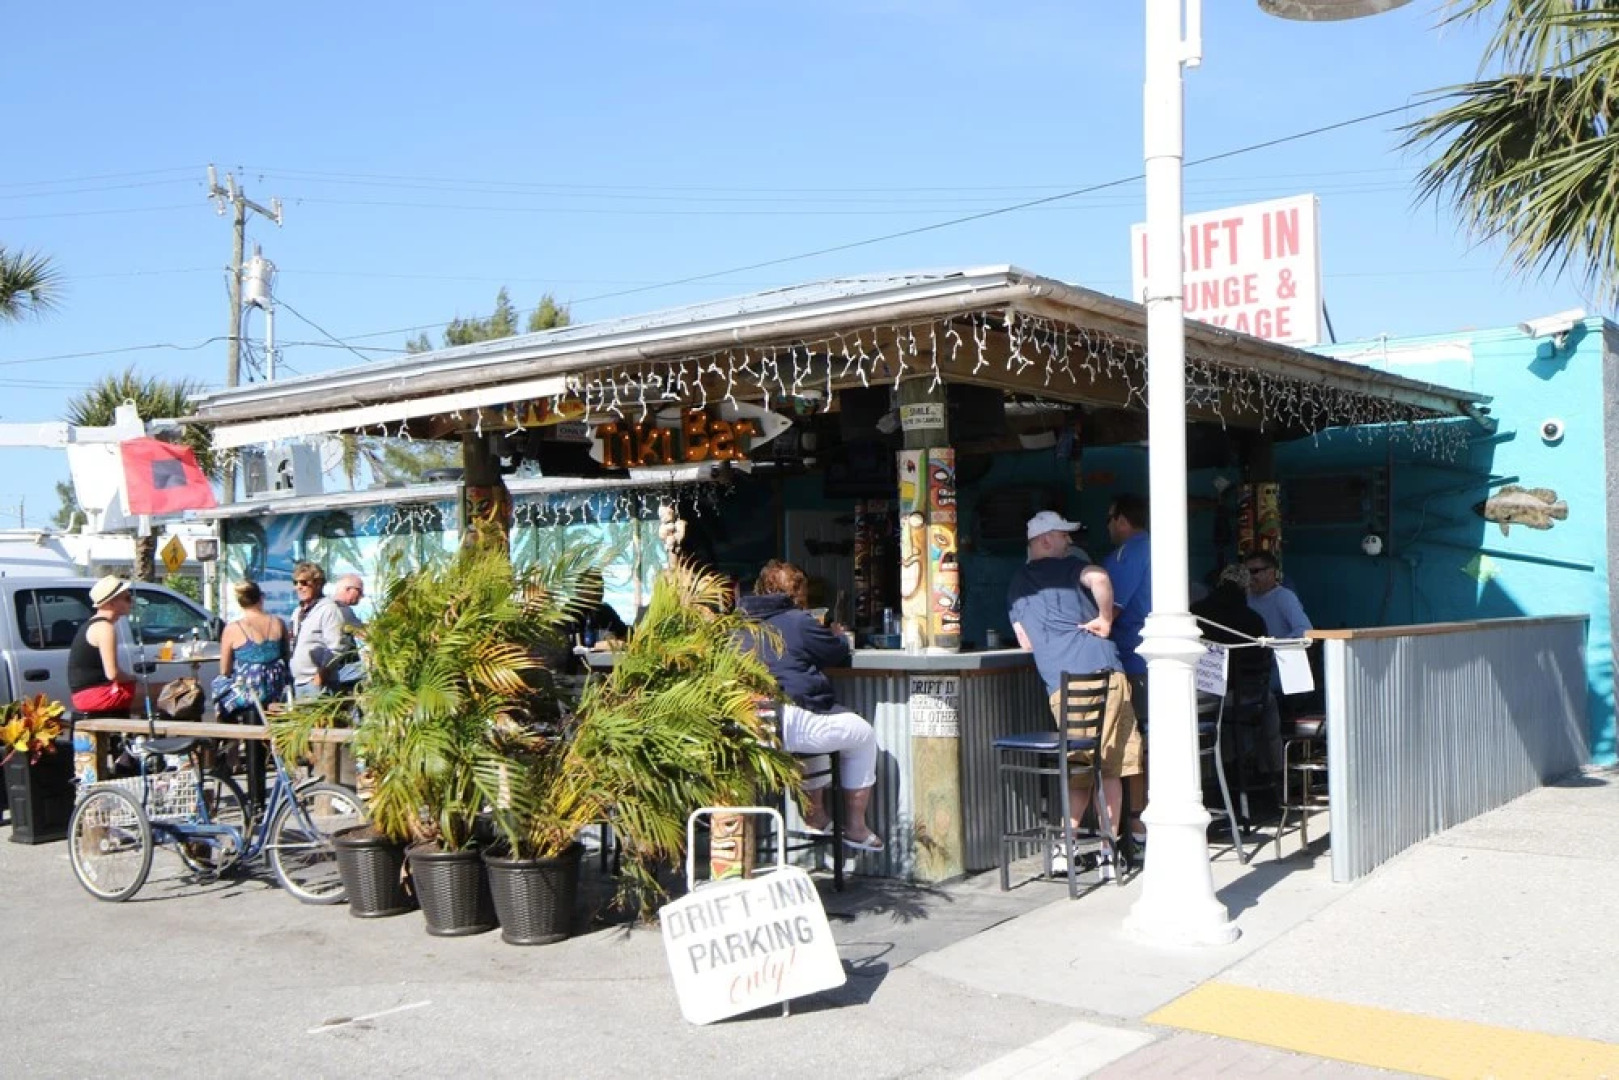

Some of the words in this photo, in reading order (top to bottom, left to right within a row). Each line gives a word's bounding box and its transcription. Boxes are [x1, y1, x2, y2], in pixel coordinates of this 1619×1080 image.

[1142, 217, 1244, 279] IFT
[1262, 208, 1299, 260] IN
[1276, 268, 1297, 300] &
[687, 915, 814, 974] PARKING
